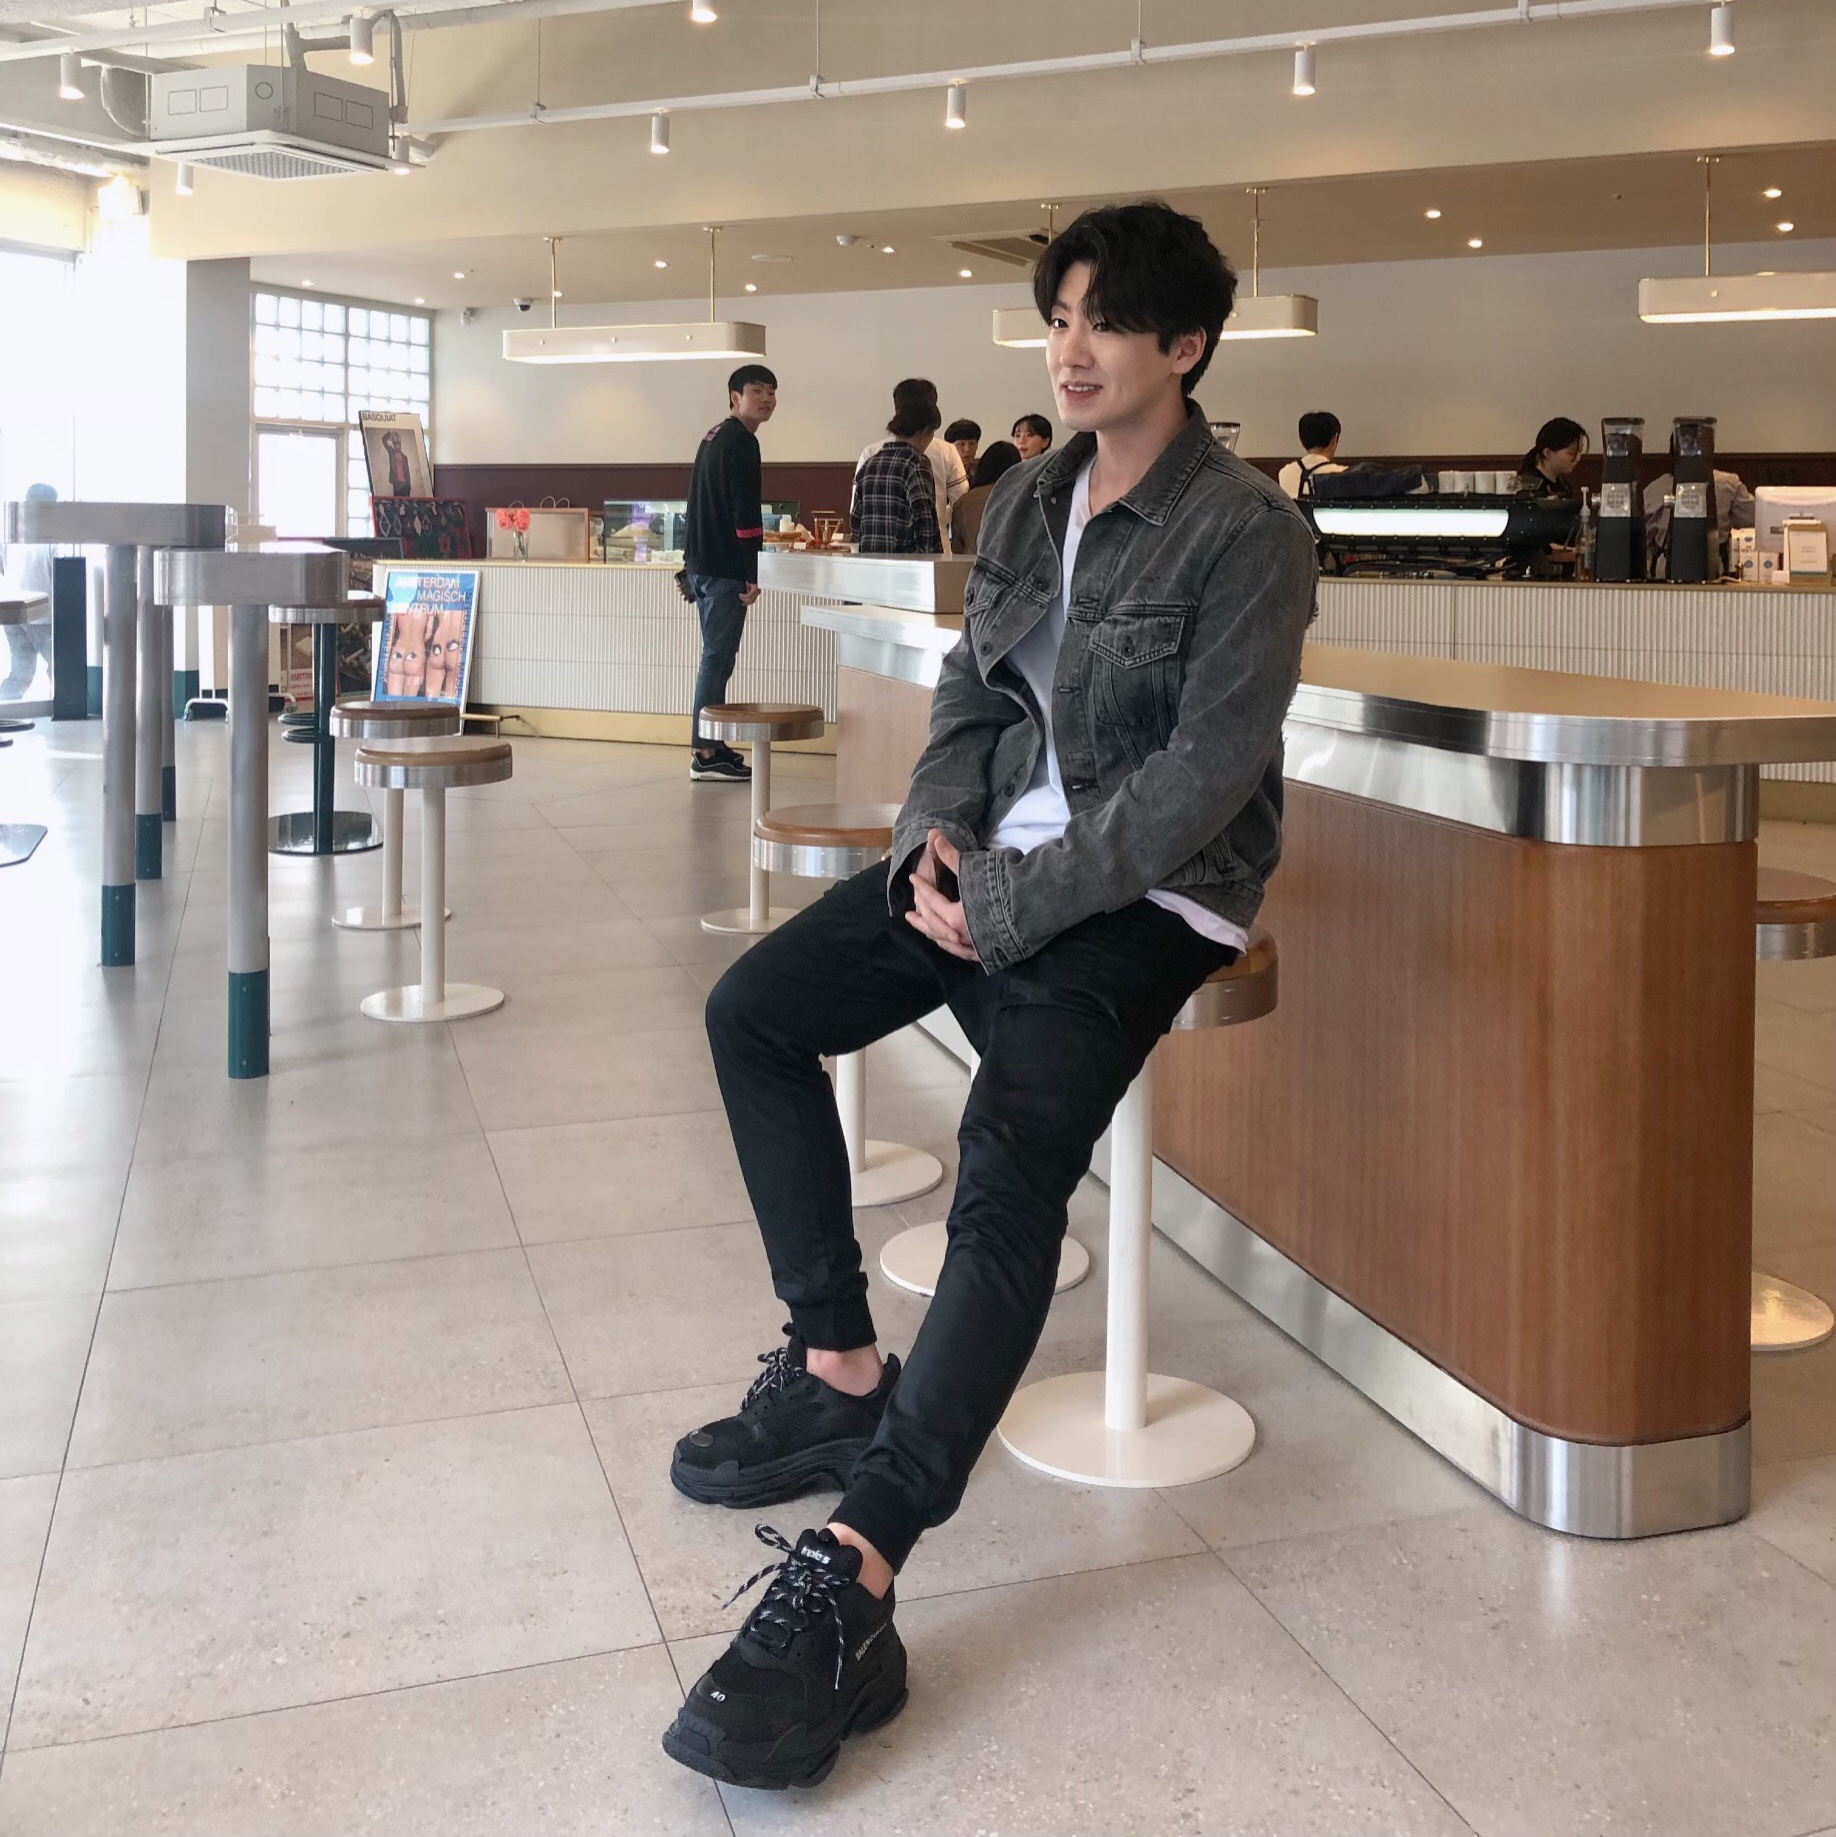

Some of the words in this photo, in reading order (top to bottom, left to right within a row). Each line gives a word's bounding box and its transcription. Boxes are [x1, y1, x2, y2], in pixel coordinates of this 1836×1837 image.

[362, 412, 396, 422] BASQUIAT
[395, 576, 460, 589] TERDAM
[417, 590, 467, 602] MAGISCH
[390, 602, 444, 615] NTRUM
[710, 1691, 726, 1702] 40
